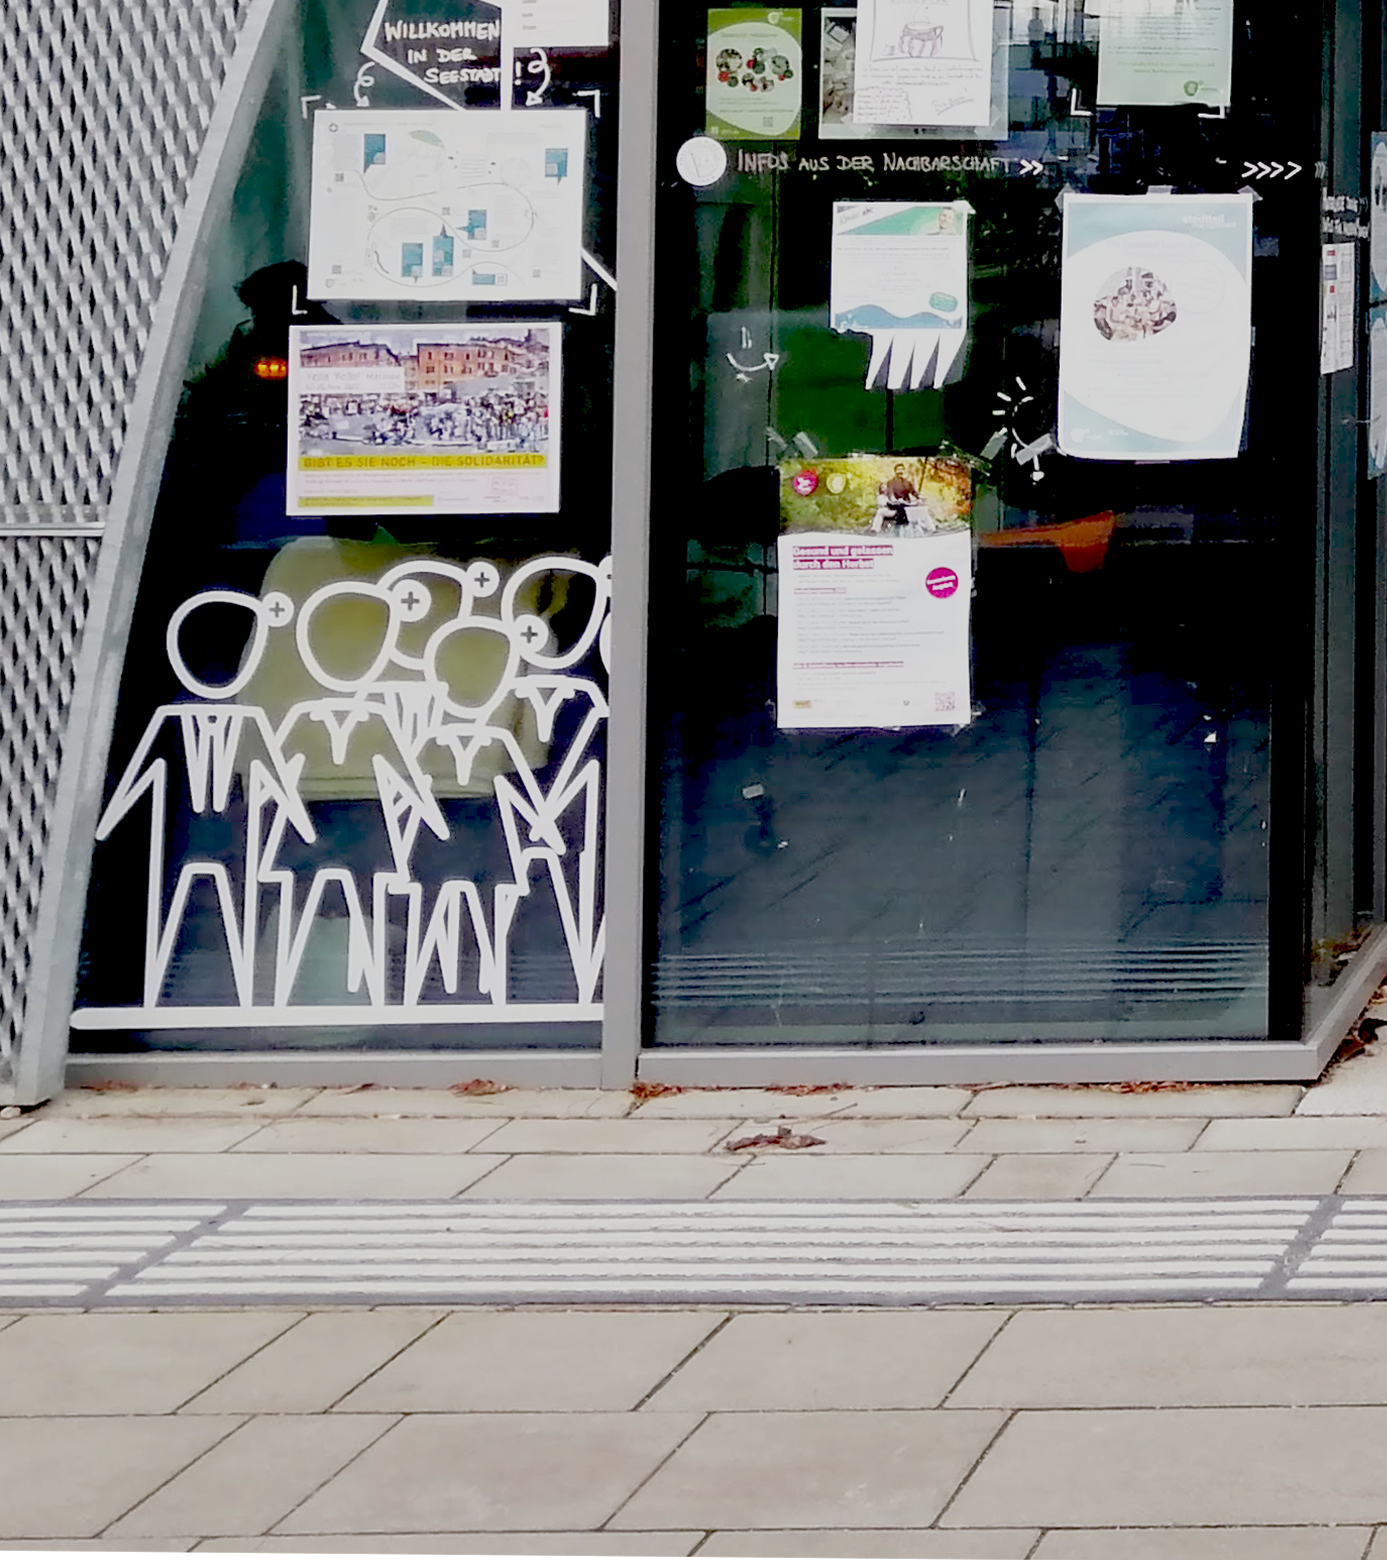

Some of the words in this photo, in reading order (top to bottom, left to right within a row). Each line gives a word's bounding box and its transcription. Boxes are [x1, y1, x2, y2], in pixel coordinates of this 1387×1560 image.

[384, 19, 501, 42] WILLKOMMEN
[407, 49, 429, 65] IN
[436, 47, 477, 63] DER
[738, 151, 790, 172] INFOS
[798, 155, 831, 171] AUS
[836, 154, 875, 172] DER
[882, 151, 1018, 173] NACHBARSCHAFT
[303, 457, 332, 468] GIBT
[335, 457, 352, 468] ES
[356, 456, 376, 467] SIE
[380, 456, 416, 467] NOCH
[431, 456, 452, 467] DIE
